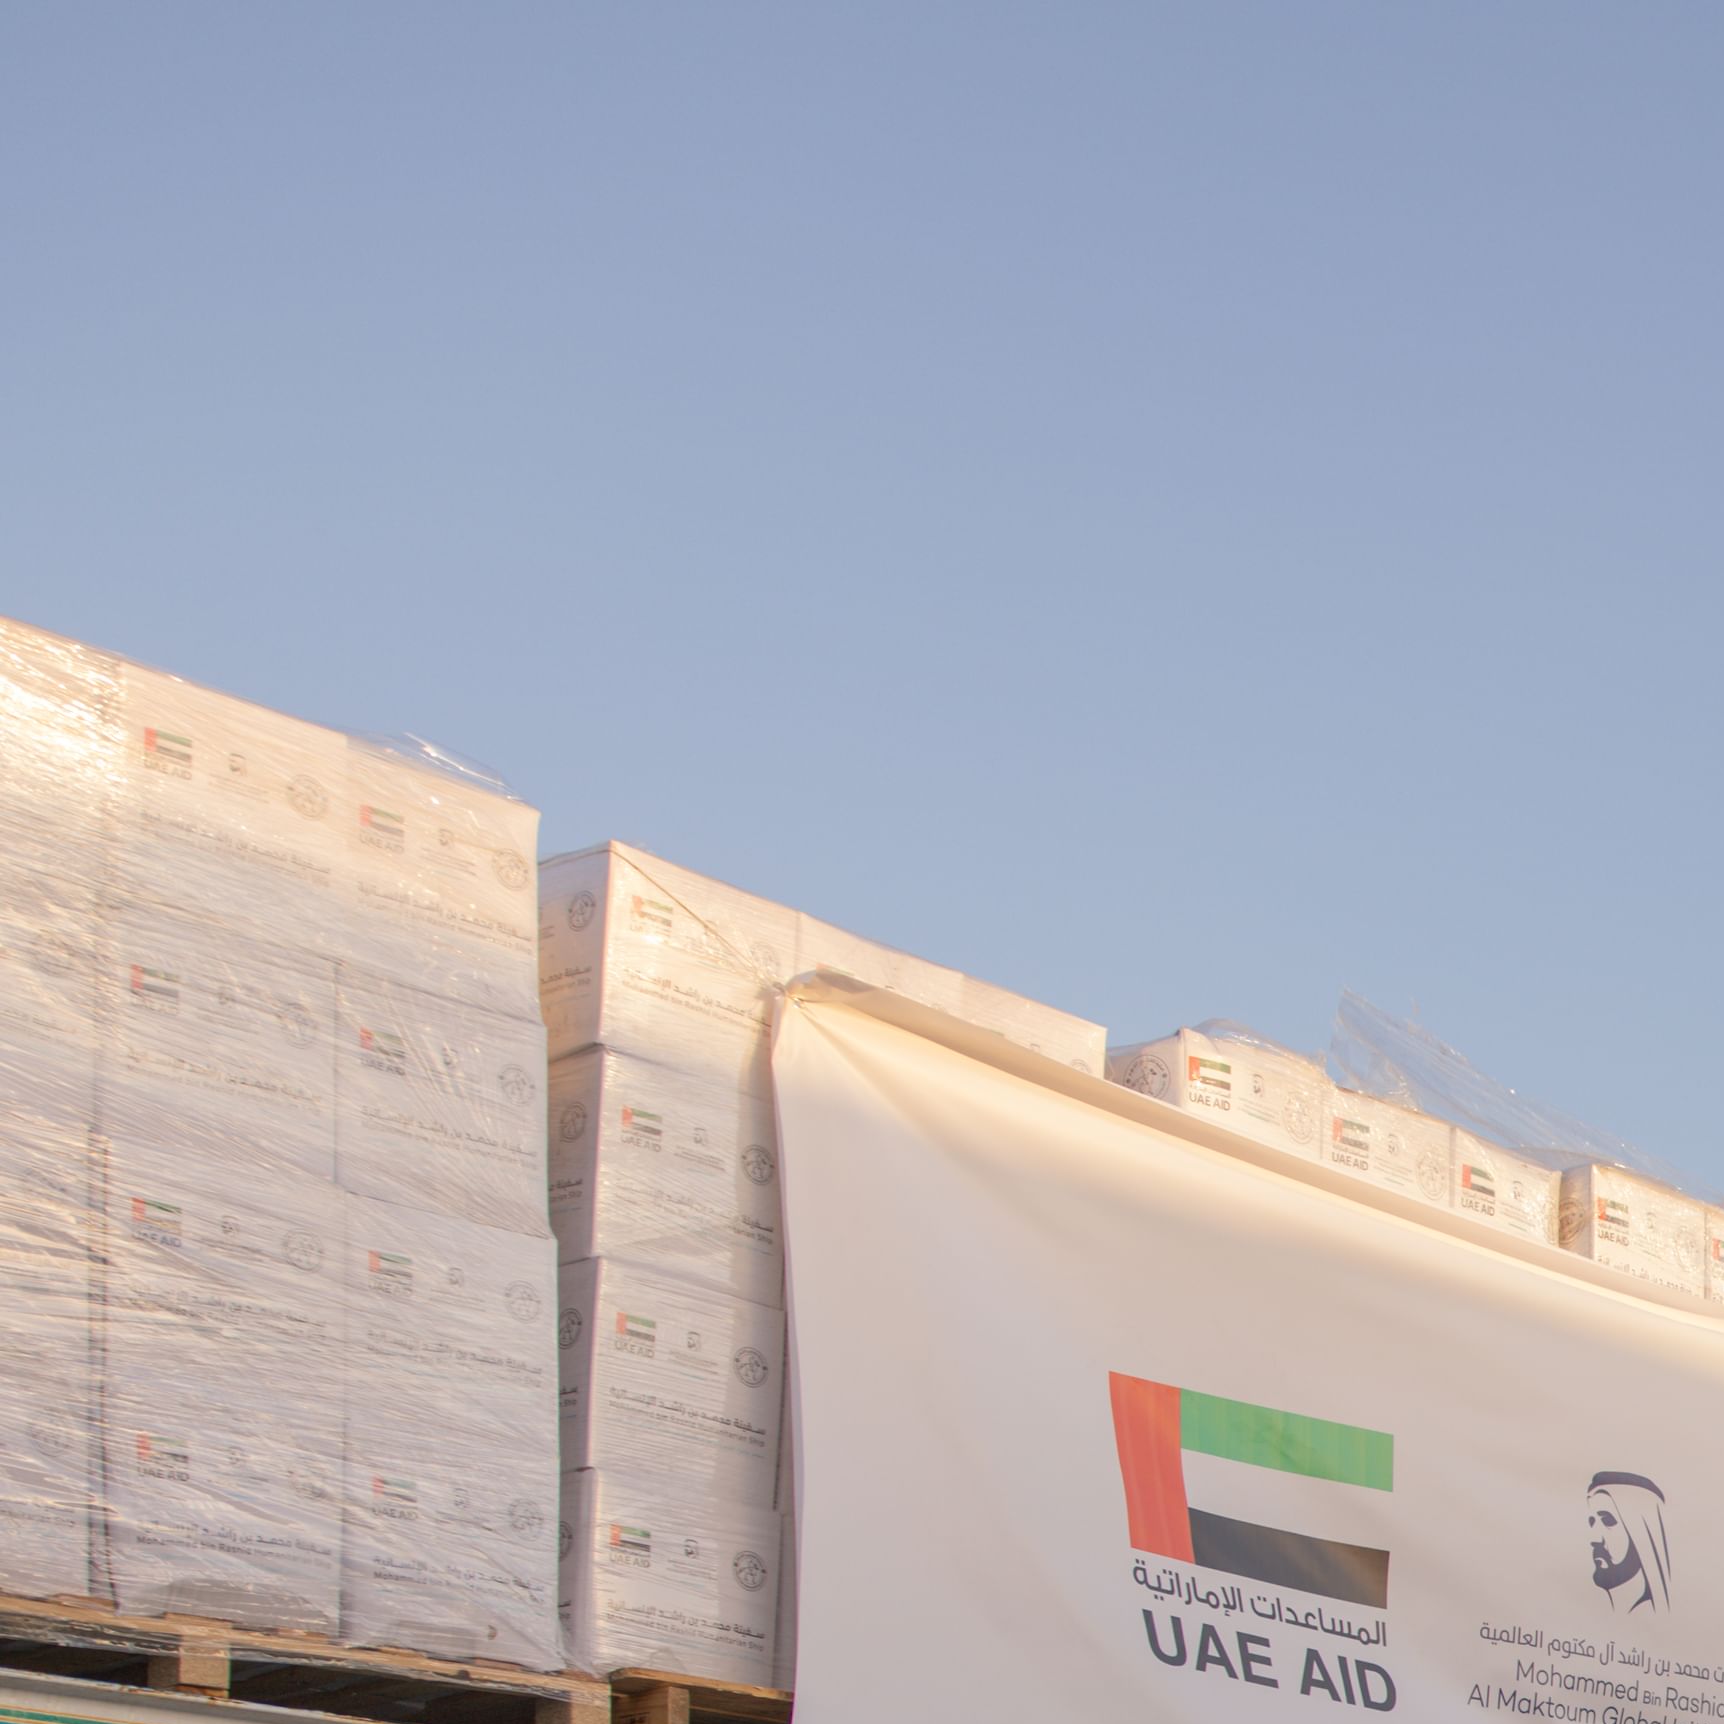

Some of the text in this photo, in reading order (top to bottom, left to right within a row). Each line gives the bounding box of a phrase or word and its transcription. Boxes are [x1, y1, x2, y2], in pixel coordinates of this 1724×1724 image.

[1189, 1092, 1231, 1111] UAE AID
[1332, 1151, 1369, 1171] UAE AID
[1461, 1197, 1496, 1217] UAE AID
[1616, 1234, 1630, 1247] AID
[614, 1339, 655, 1359] UAE AID
[609, 1552, 651, 1568] UAE AID
[1132, 1558, 1387, 1648] المساعدات الإماراتية
[1479, 1621, 1543, 1649] العالمية
[1547, 1637, 1596, 1659] مكتوم
[1599, 1640, 1615, 1666] آل
[1142, 1608, 1397, 1712] UAE AID
[1618, 1647, 1651, 1674] راشد
[1655, 1657, 1671, 1677] بن
[1674, 1660, 1710, 1680] محمد
[1515, 1659, 1640, 1702] Mohammed
[1642, 1690, 1662, 1707] Bin
[1467, 1683, 1491, 1708] Al
[1497, 1688, 1597, 1724] Maktoum
